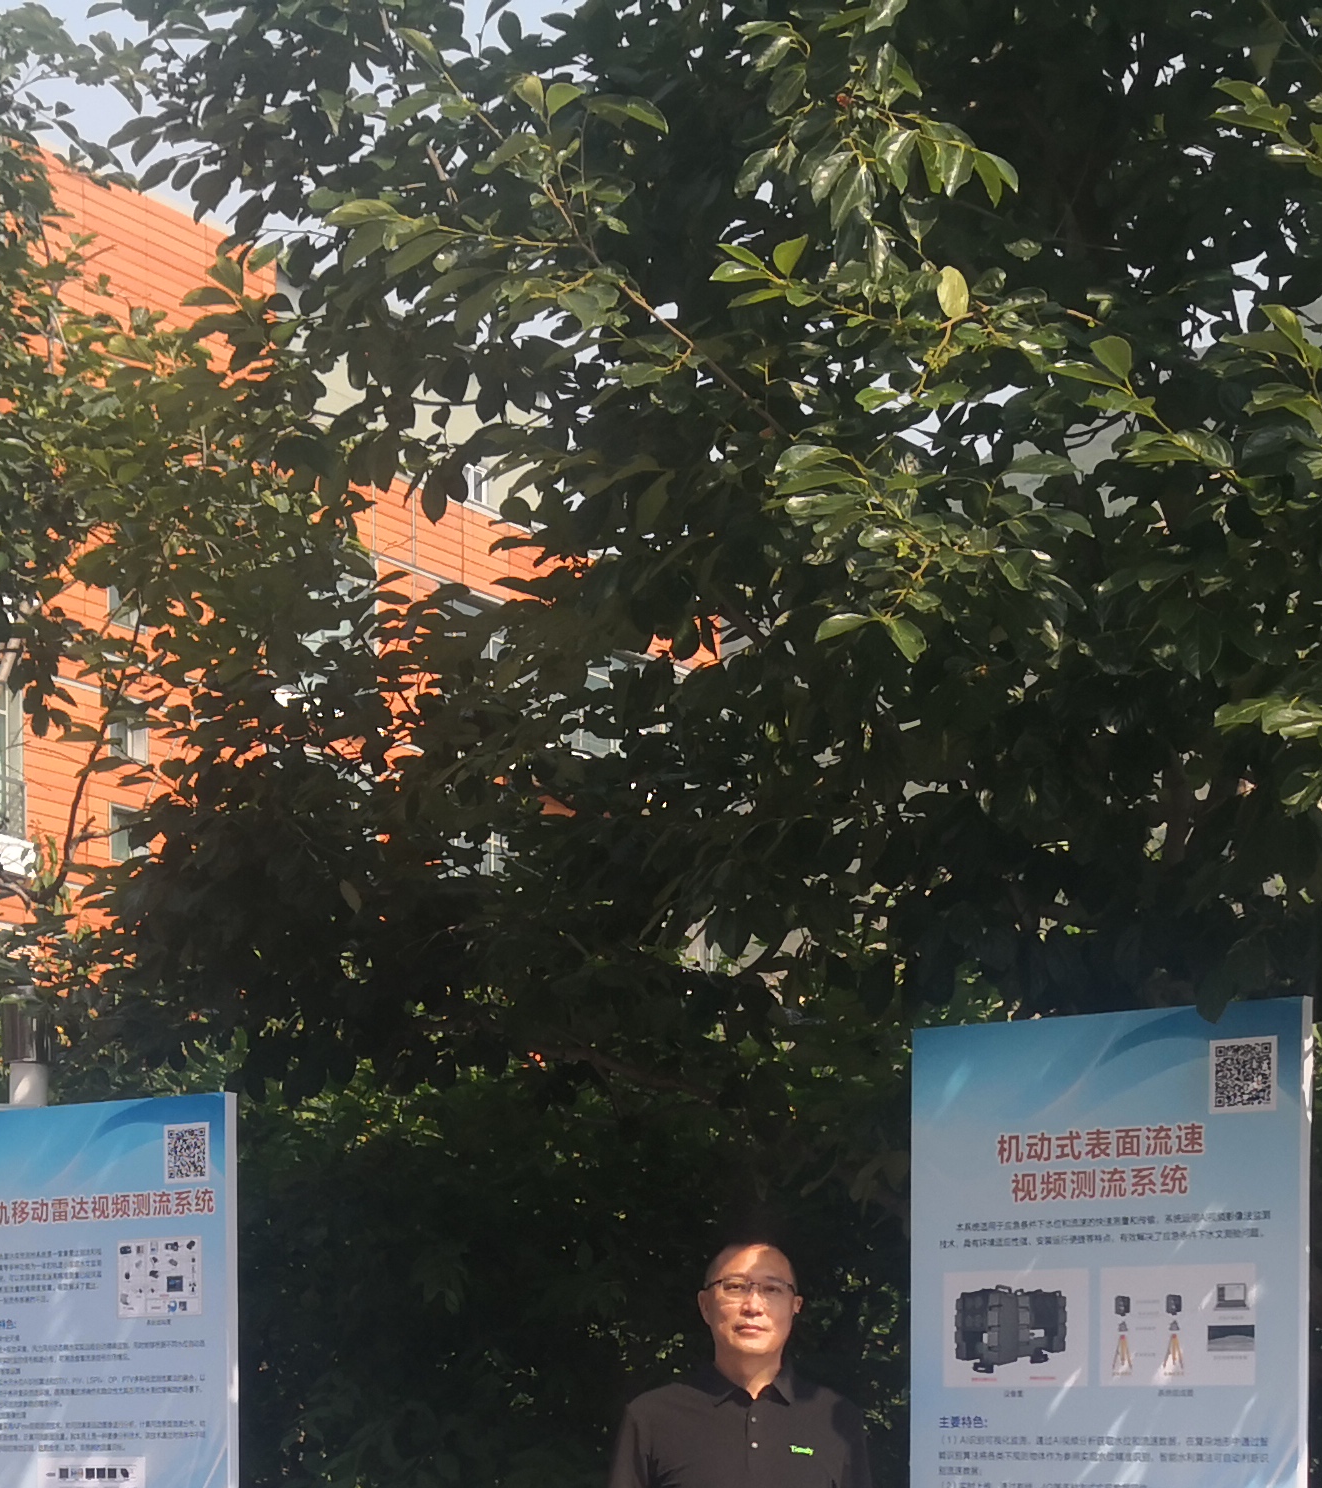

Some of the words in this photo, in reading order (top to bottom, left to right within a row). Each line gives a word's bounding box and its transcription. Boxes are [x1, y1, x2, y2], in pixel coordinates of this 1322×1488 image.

[997, 1122, 1204, 1164] 机动式表面流速
[1011, 1165, 1189, 1202] 视频测流系统
